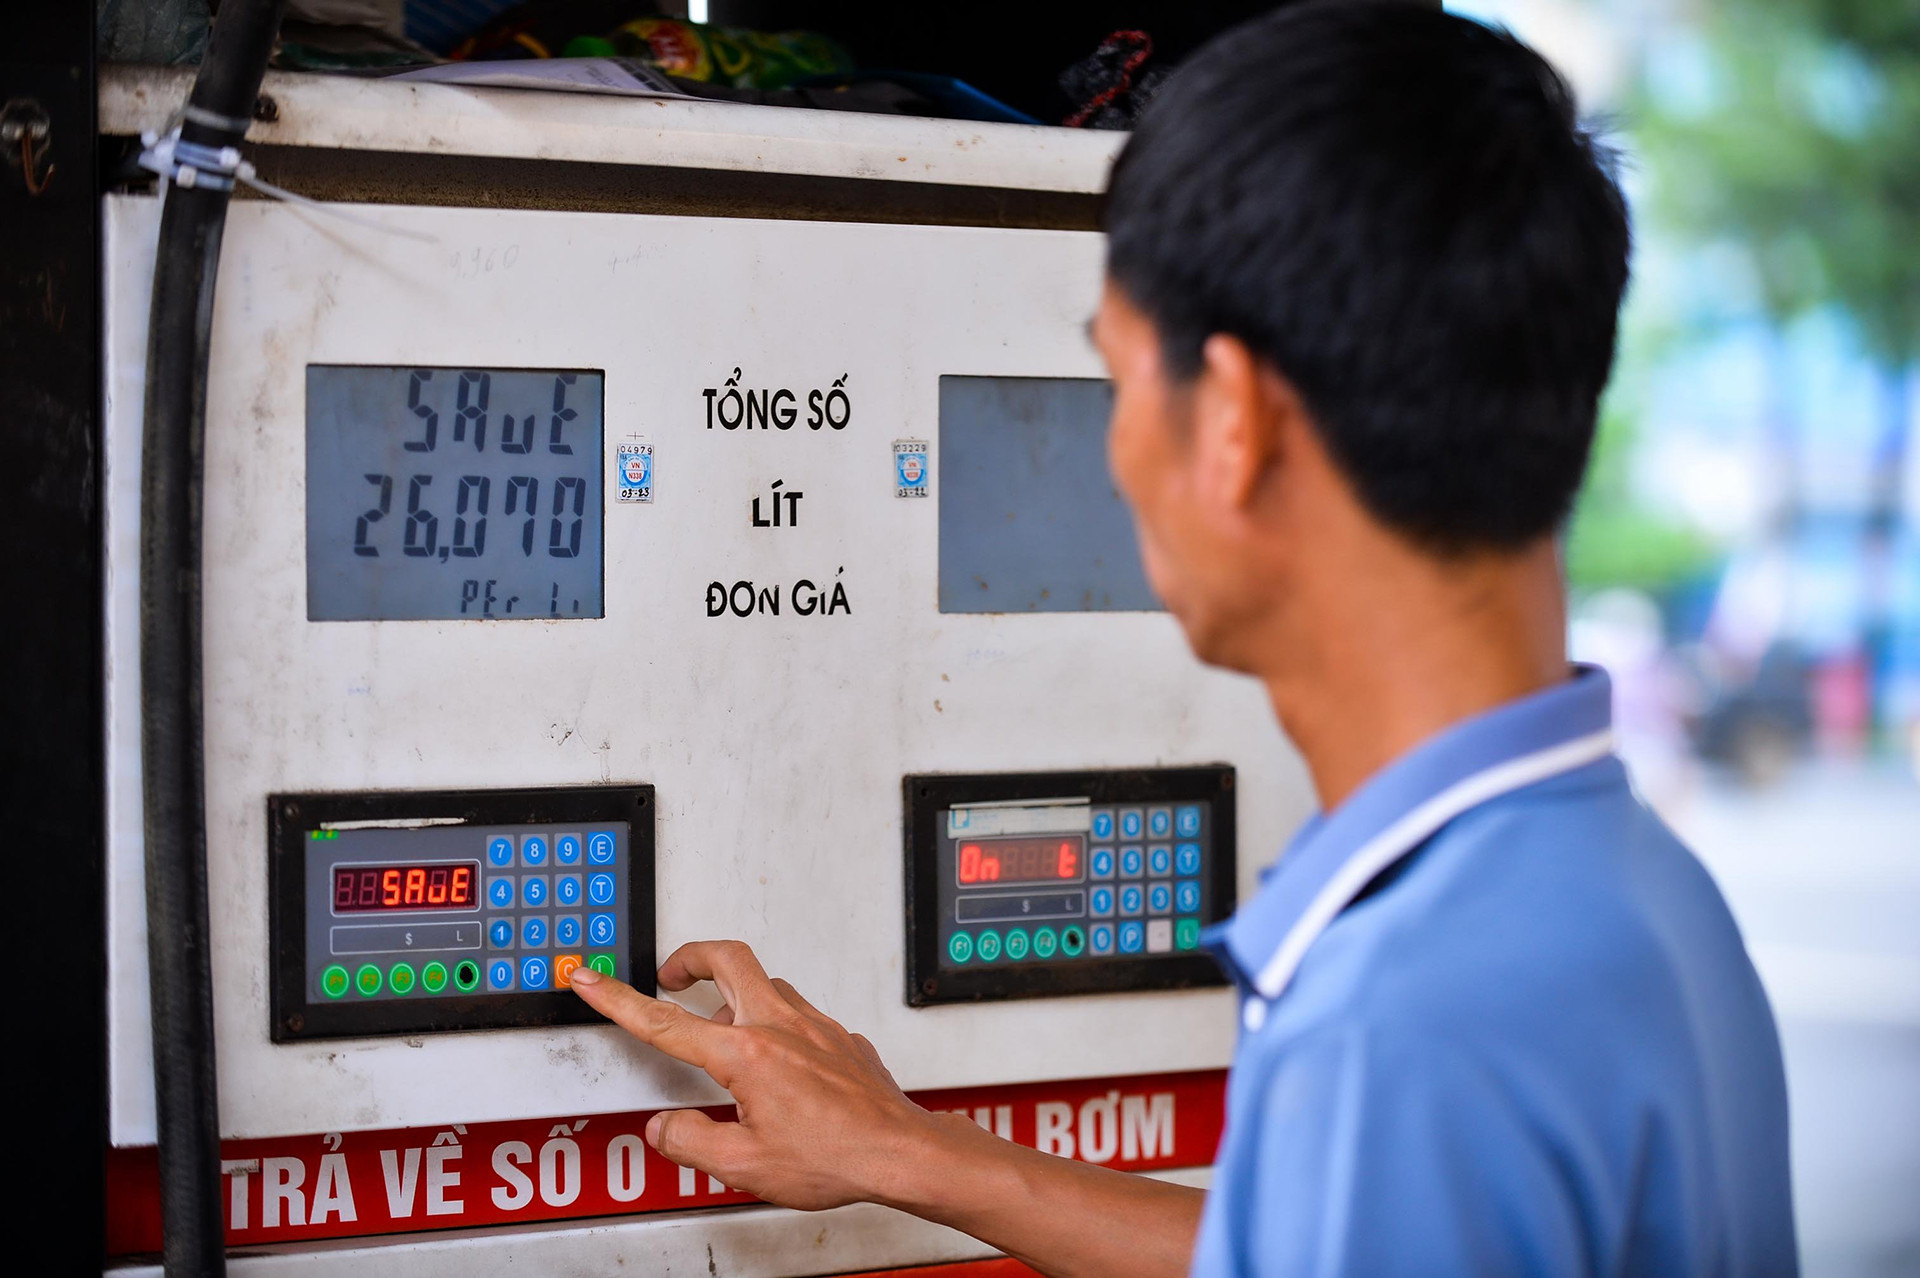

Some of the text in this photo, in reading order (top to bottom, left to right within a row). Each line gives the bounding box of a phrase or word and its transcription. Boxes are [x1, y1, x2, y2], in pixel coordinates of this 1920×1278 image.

[702, 366, 851, 431] TỔNG SỐ
[620, 445, 653, 456] 04979
[752, 478, 804, 528] LÍT
[353, 473, 587, 564] 26,070
[1098, 817, 1108, 831] 7
[496, 841, 607, 859] 7 8 9 E
[1097, 855, 1108, 871] 4
[496, 881, 606, 900] 4 5 6 T
[1099, 894, 1106, 910] 1
[1127, 891, 1136, 909] 2
[1155, 891, 1165, 908] 3
[405, 930, 464, 946] $ L
[497, 920, 607, 941] 1 2 3 $
[497, 966, 506, 982] 0
[530, 965, 540, 980] P
[1035, 1091, 1176, 1163] BƠM
[222, 1132, 358, 1231] TRẢ
[379, 1124, 468, 1219] VỀ
[490, 1119, 590, 1211] SỐ
